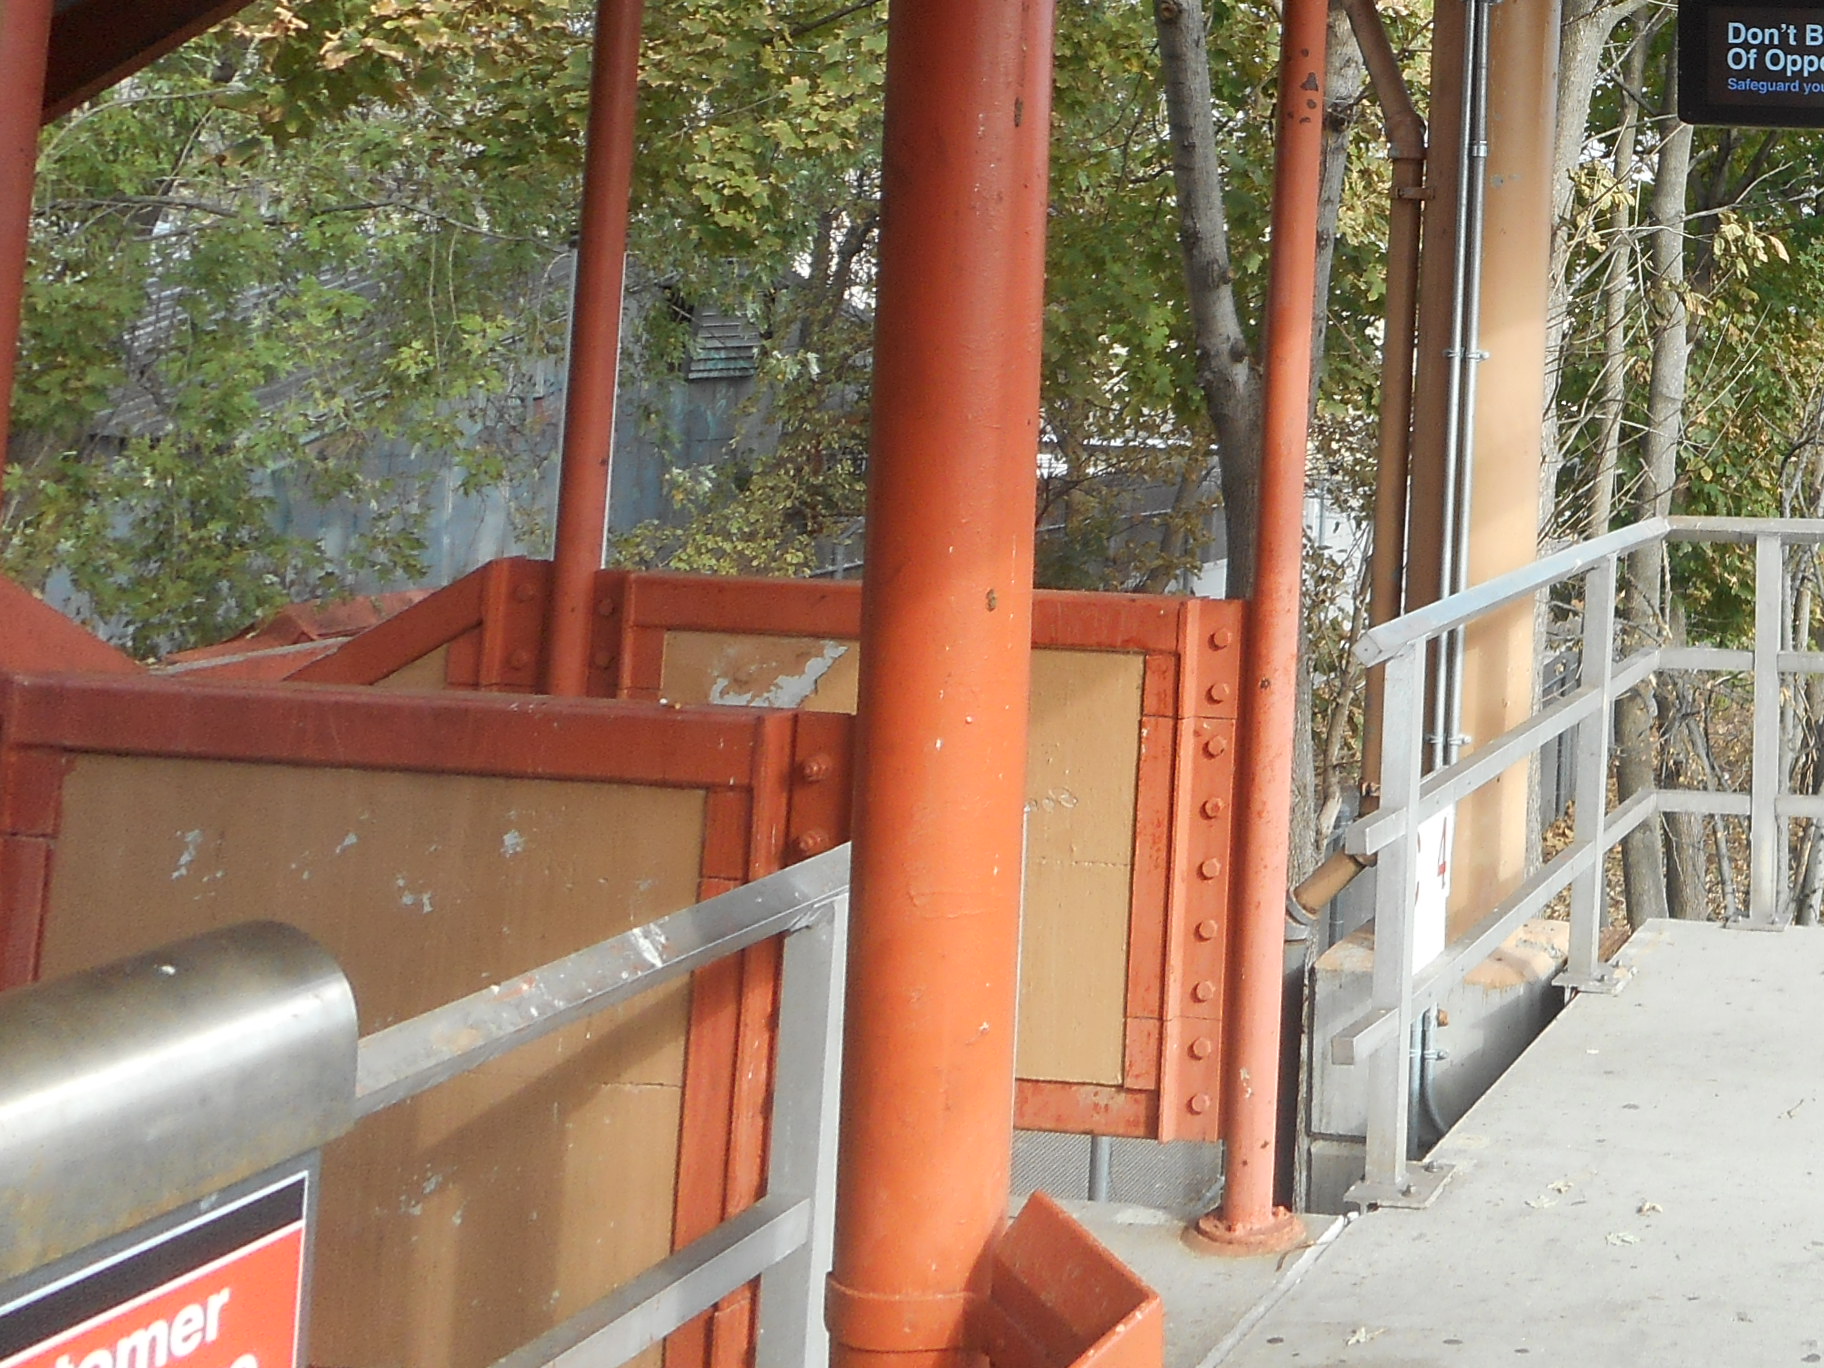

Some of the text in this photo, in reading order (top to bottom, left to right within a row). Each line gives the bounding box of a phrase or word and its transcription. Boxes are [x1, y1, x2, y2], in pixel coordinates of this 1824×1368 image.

[1727, 22, 1797, 46] Don't
[1727, 47, 1757, 70] Of
[1728, 78, 1799, 94] Safeguard
[55, 1287, 231, 1368] mer
